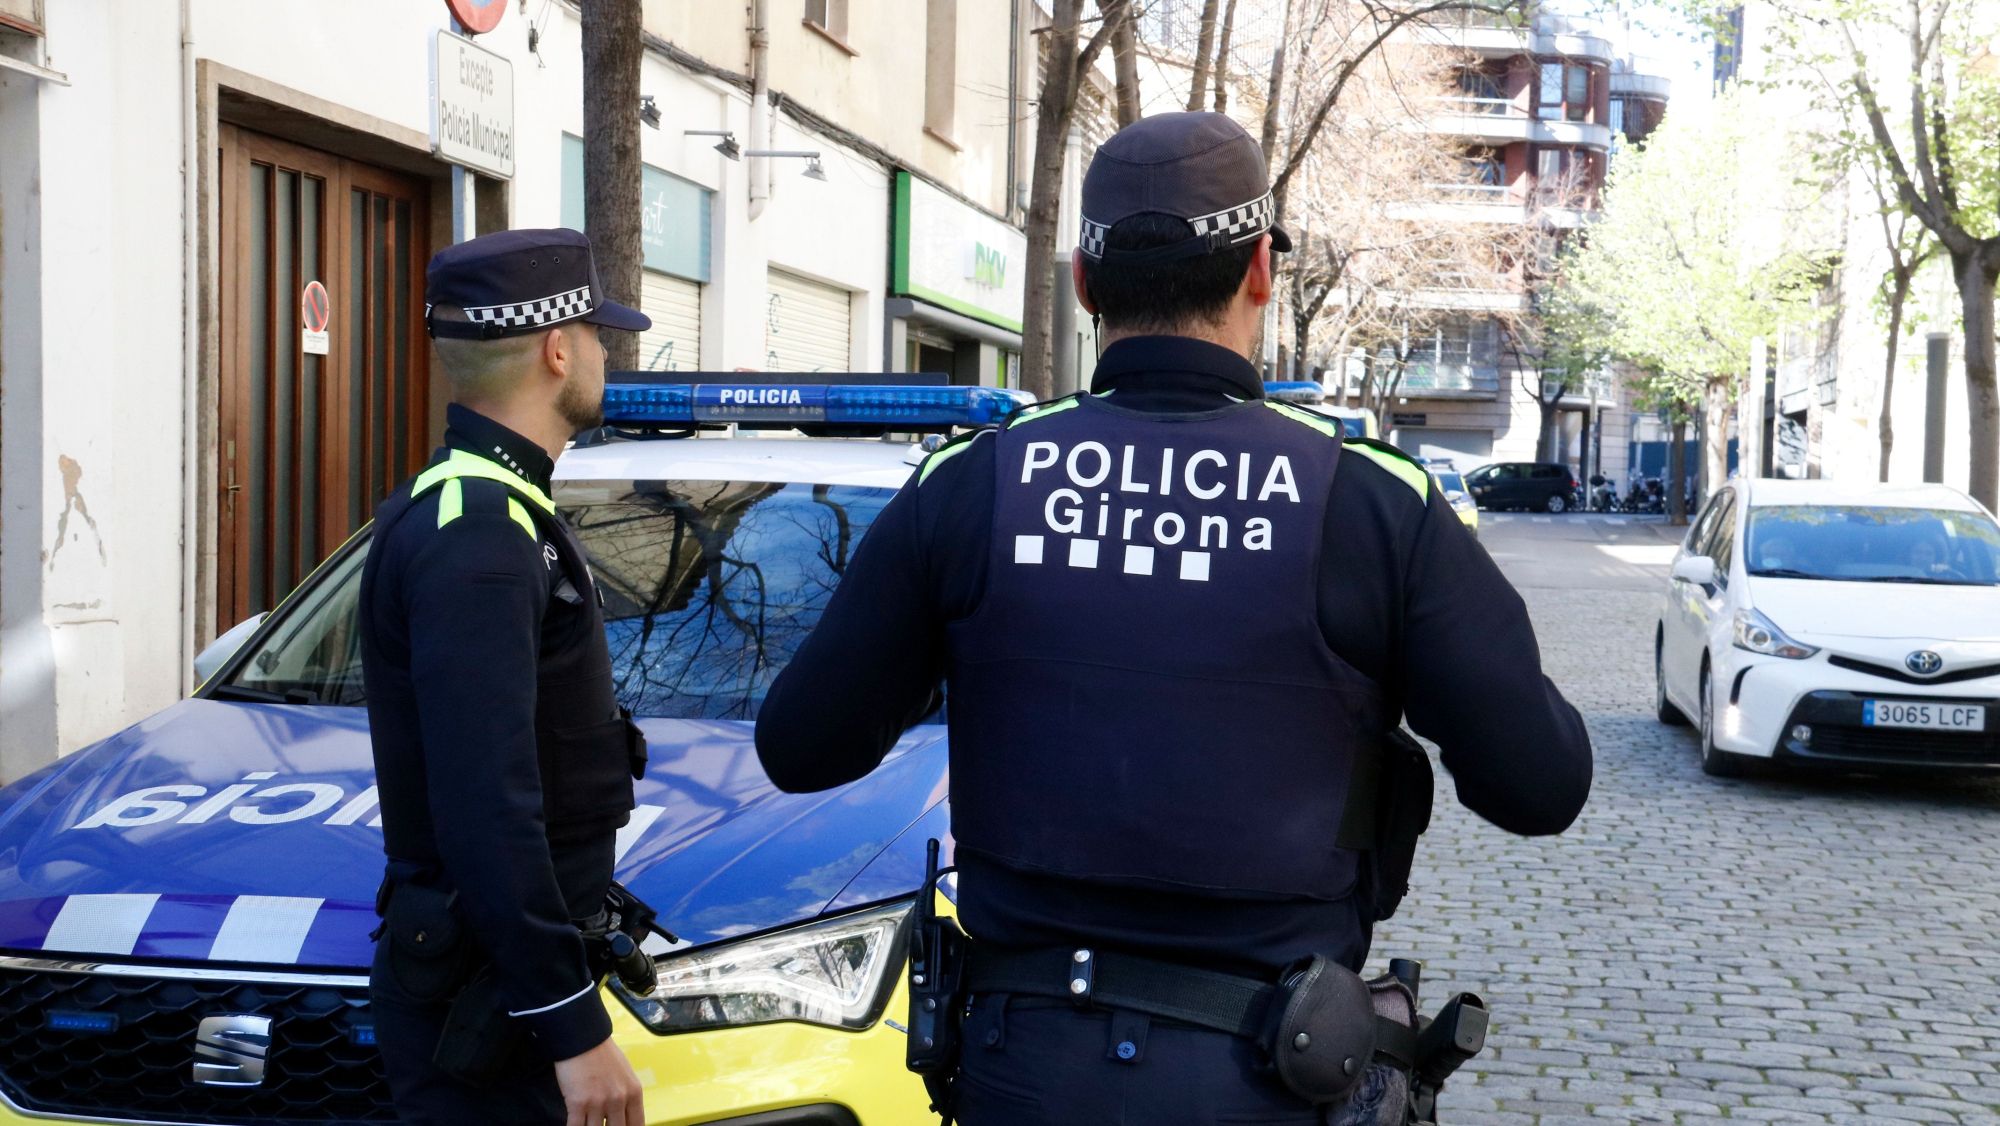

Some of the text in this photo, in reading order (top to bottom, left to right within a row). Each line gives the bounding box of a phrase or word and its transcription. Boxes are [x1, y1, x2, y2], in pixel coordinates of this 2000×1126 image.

[459, 46, 493, 102] Excepte
[472, 111, 512, 168] Municipal
[975, 240, 1007, 289] DKV
[720, 389, 802, 404] POLICIA
[1021, 440, 1301, 503] POLICIA
[1044, 488, 1273, 551] Girona
[1879, 704, 1978, 726] 3065 LCF
